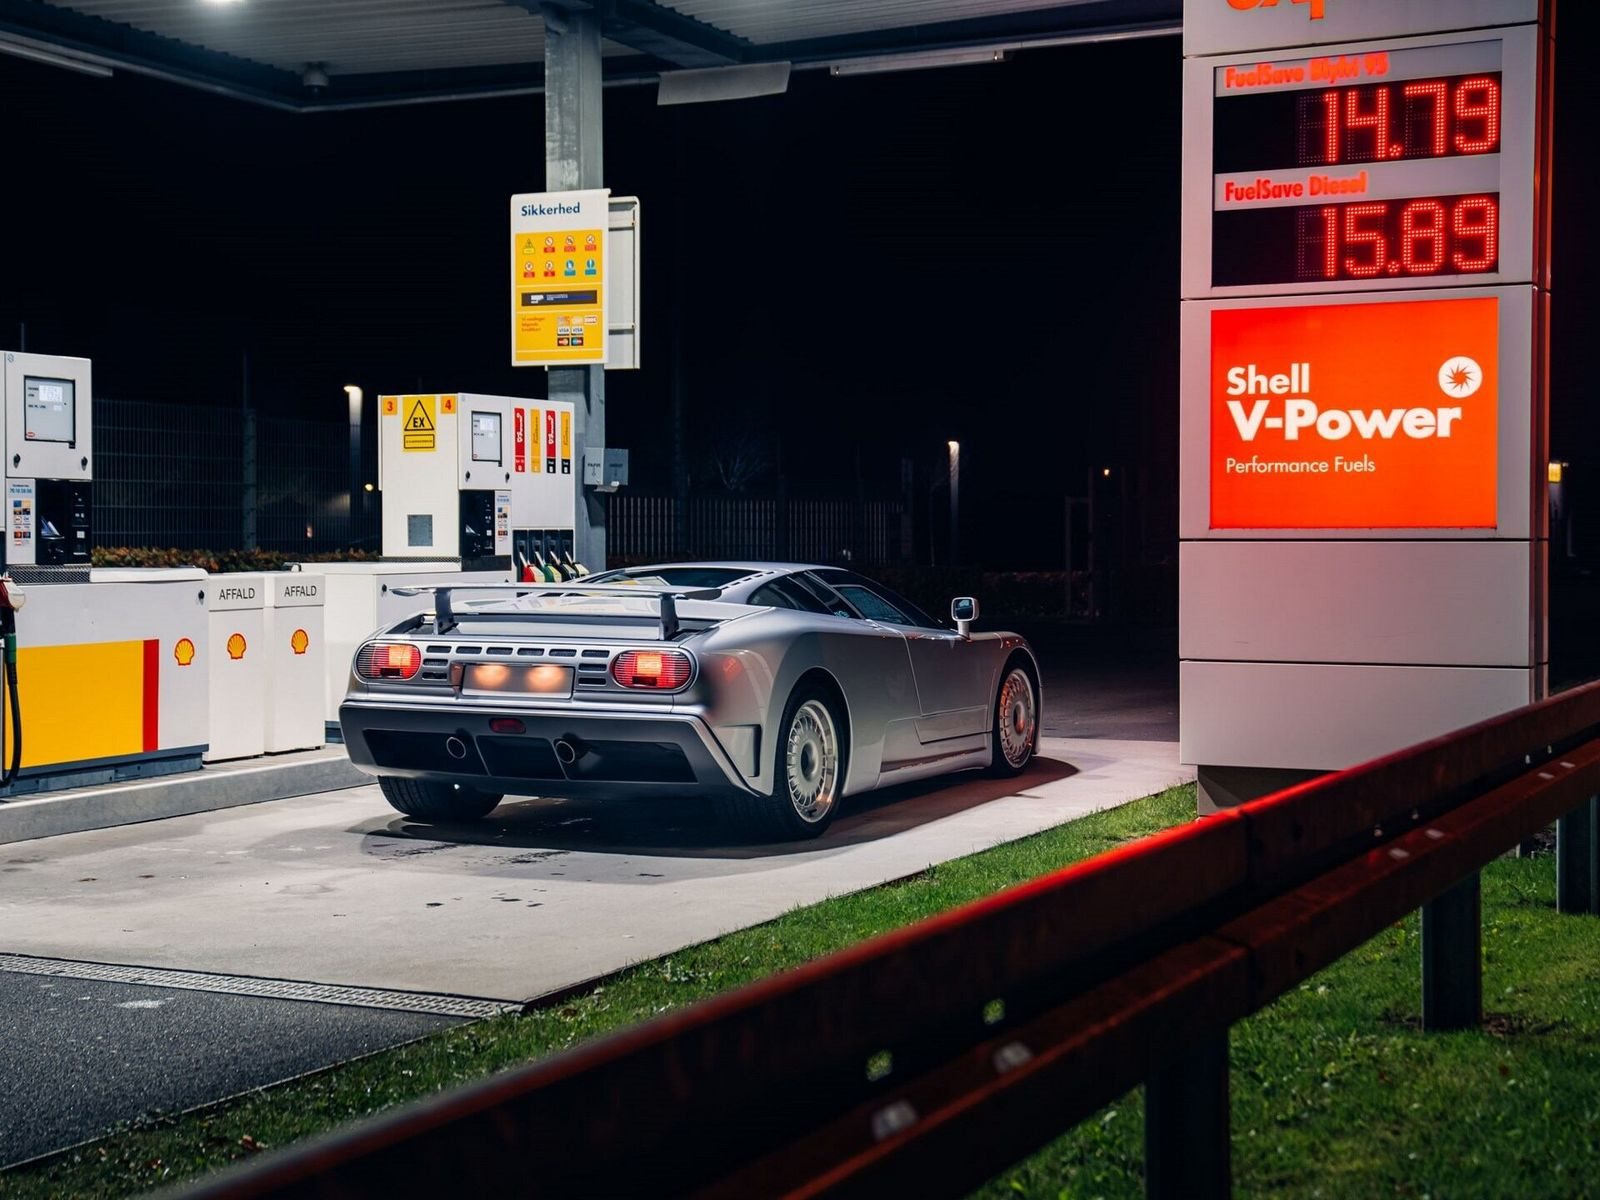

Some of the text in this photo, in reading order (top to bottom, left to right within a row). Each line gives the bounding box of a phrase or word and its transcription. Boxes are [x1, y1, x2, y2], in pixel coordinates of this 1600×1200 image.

[1225, 62, 1305, 88] FuelSave
[1324, 78, 1500, 163] 14.79
[1224, 171, 1367, 201] FuelSave Diesel
[521, 202, 580, 216] Sikkerhed
[1322, 197, 1498, 278] 15.89
[1226, 363, 1310, 395] Shell
[386, 401, 393, 412] 3
[445, 399, 452, 411] 4
[413, 417, 425, 428] EX
[1226, 399, 1462, 441] V-Power
[1226, 454, 1376, 473] Performance Fuels
[219, 587, 255, 600] AFFALD
[284, 585, 317, 597] AFFALD
